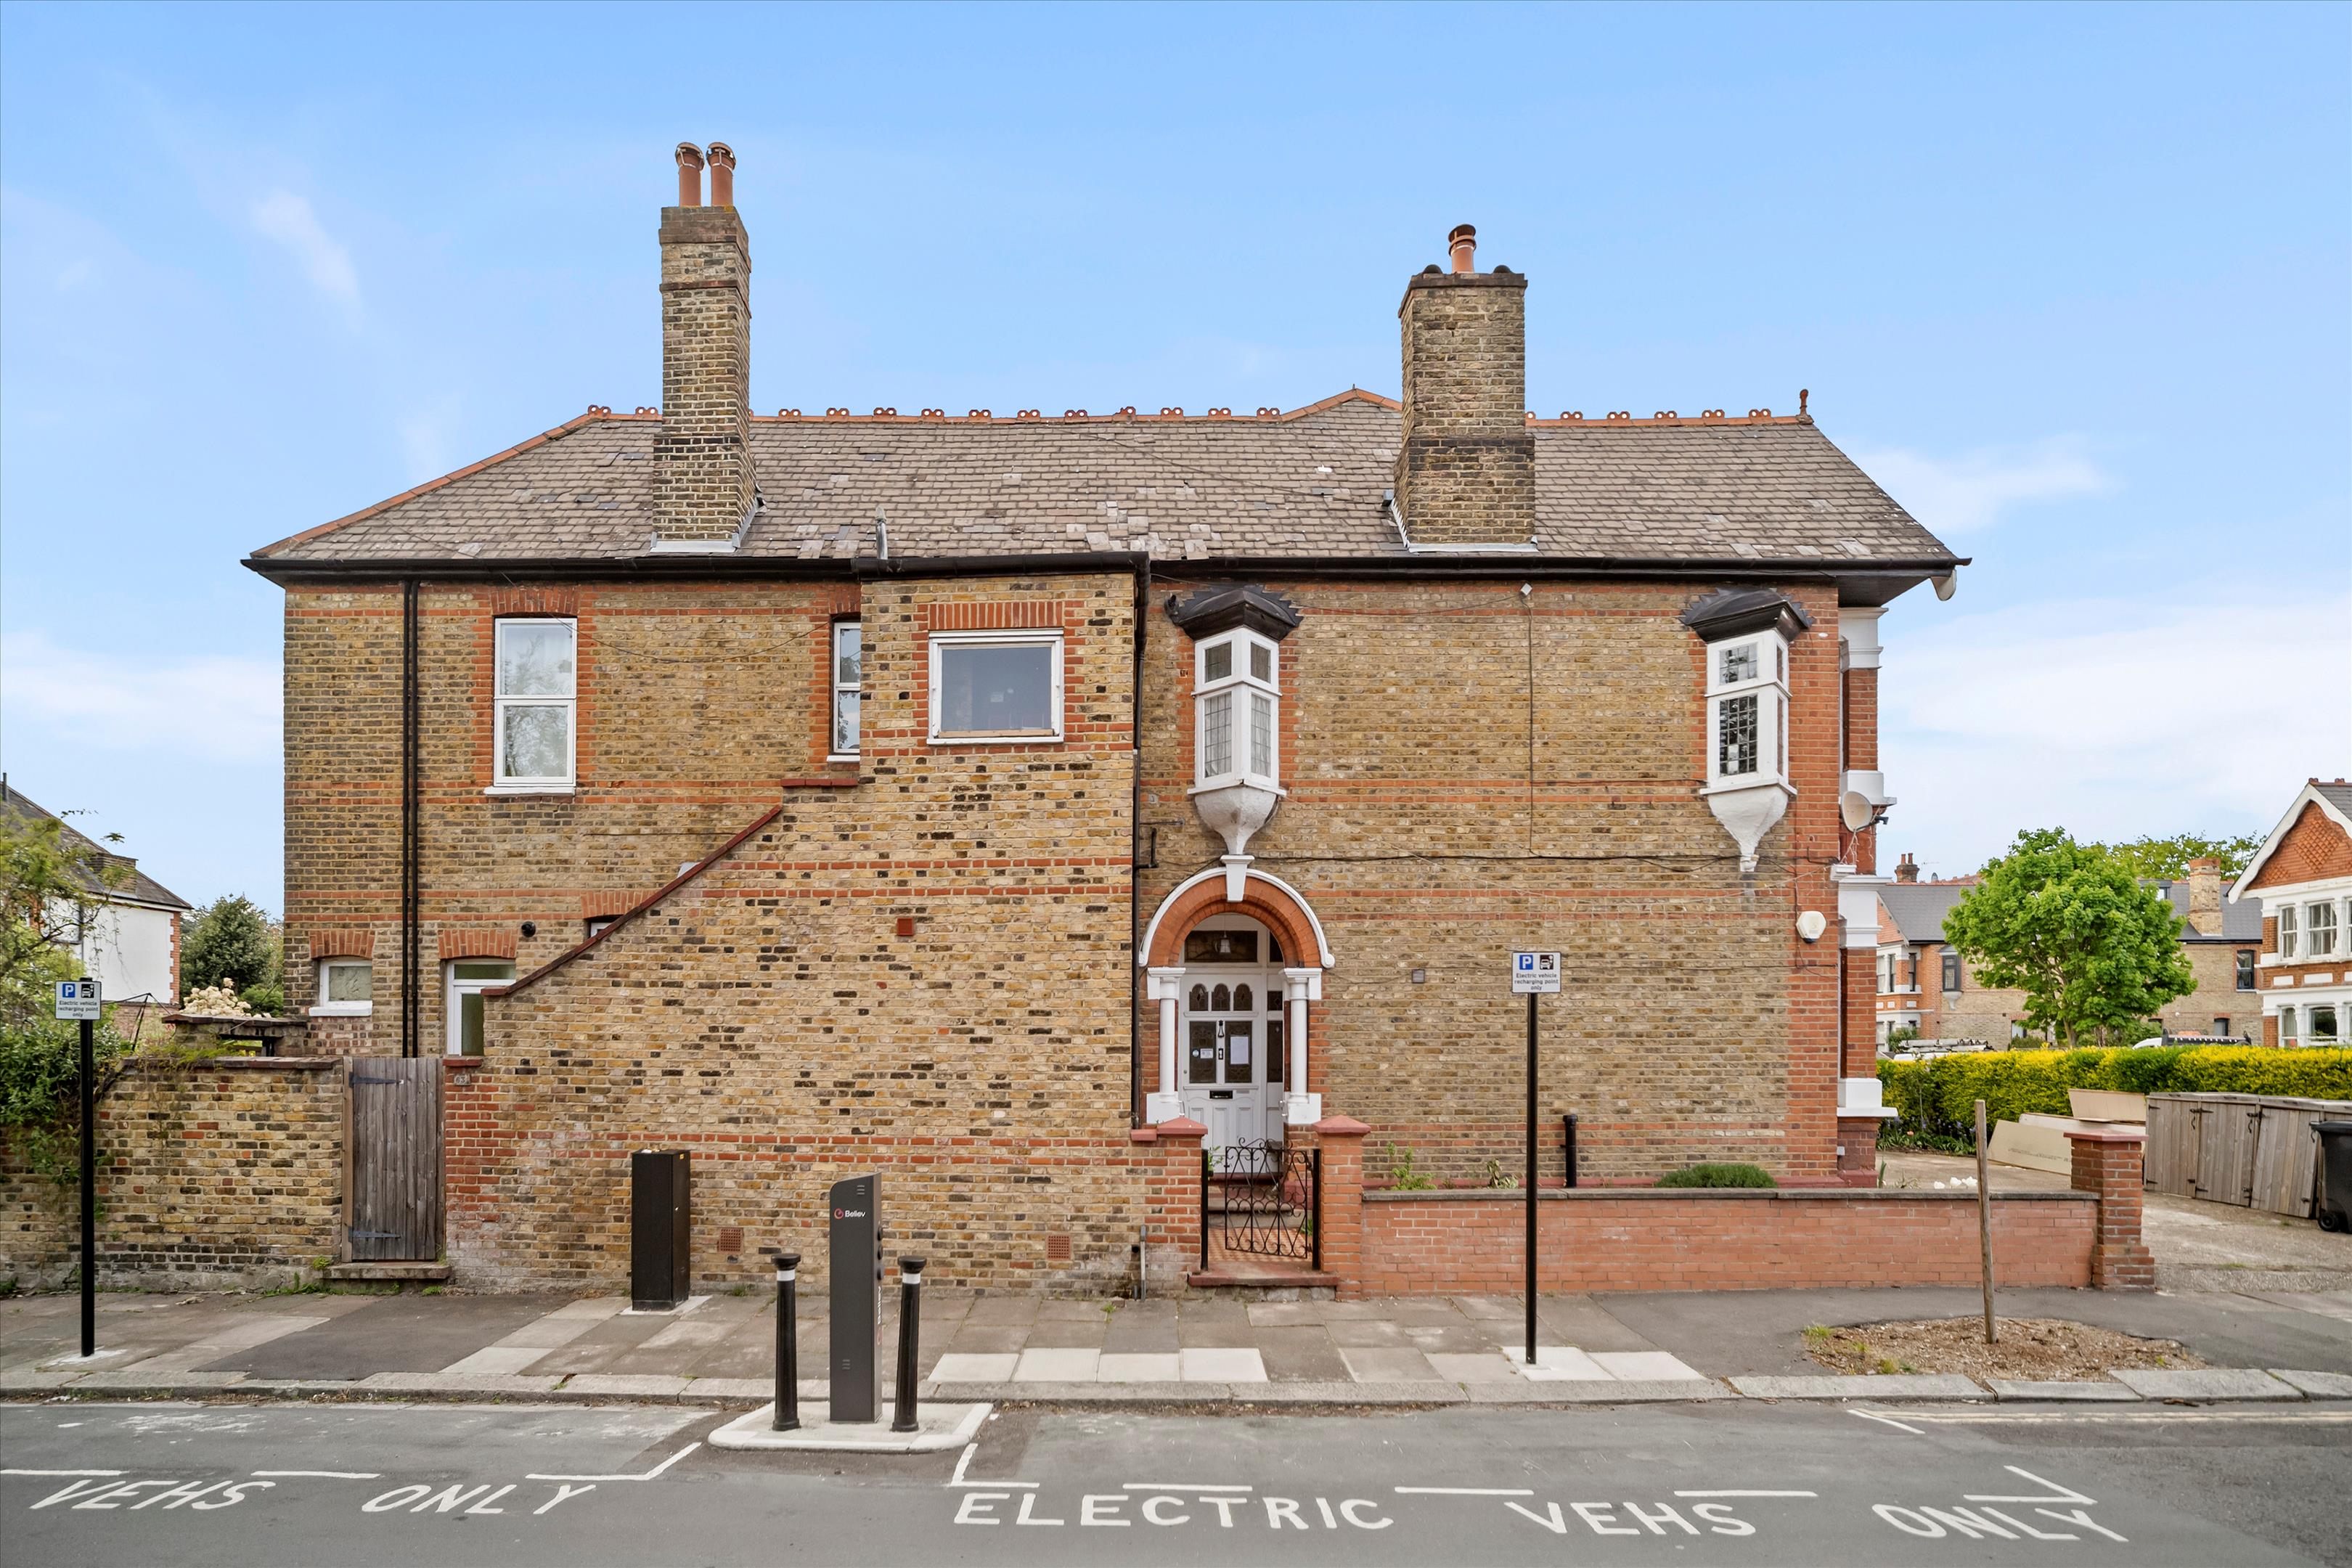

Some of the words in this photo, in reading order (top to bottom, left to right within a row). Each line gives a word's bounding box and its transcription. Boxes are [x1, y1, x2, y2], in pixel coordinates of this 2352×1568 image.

[1522, 956, 1532, 968] P
[65, 985, 73, 997] P
[30, 1480, 276, 1509] VEHS
[362, 1485, 597, 1514] ONLY
[953, 1493, 1395, 1530] ELECTRIC
[1503, 1501, 1756, 1535] VEHS
[1871, 1503, 2128, 1542] ONLY
